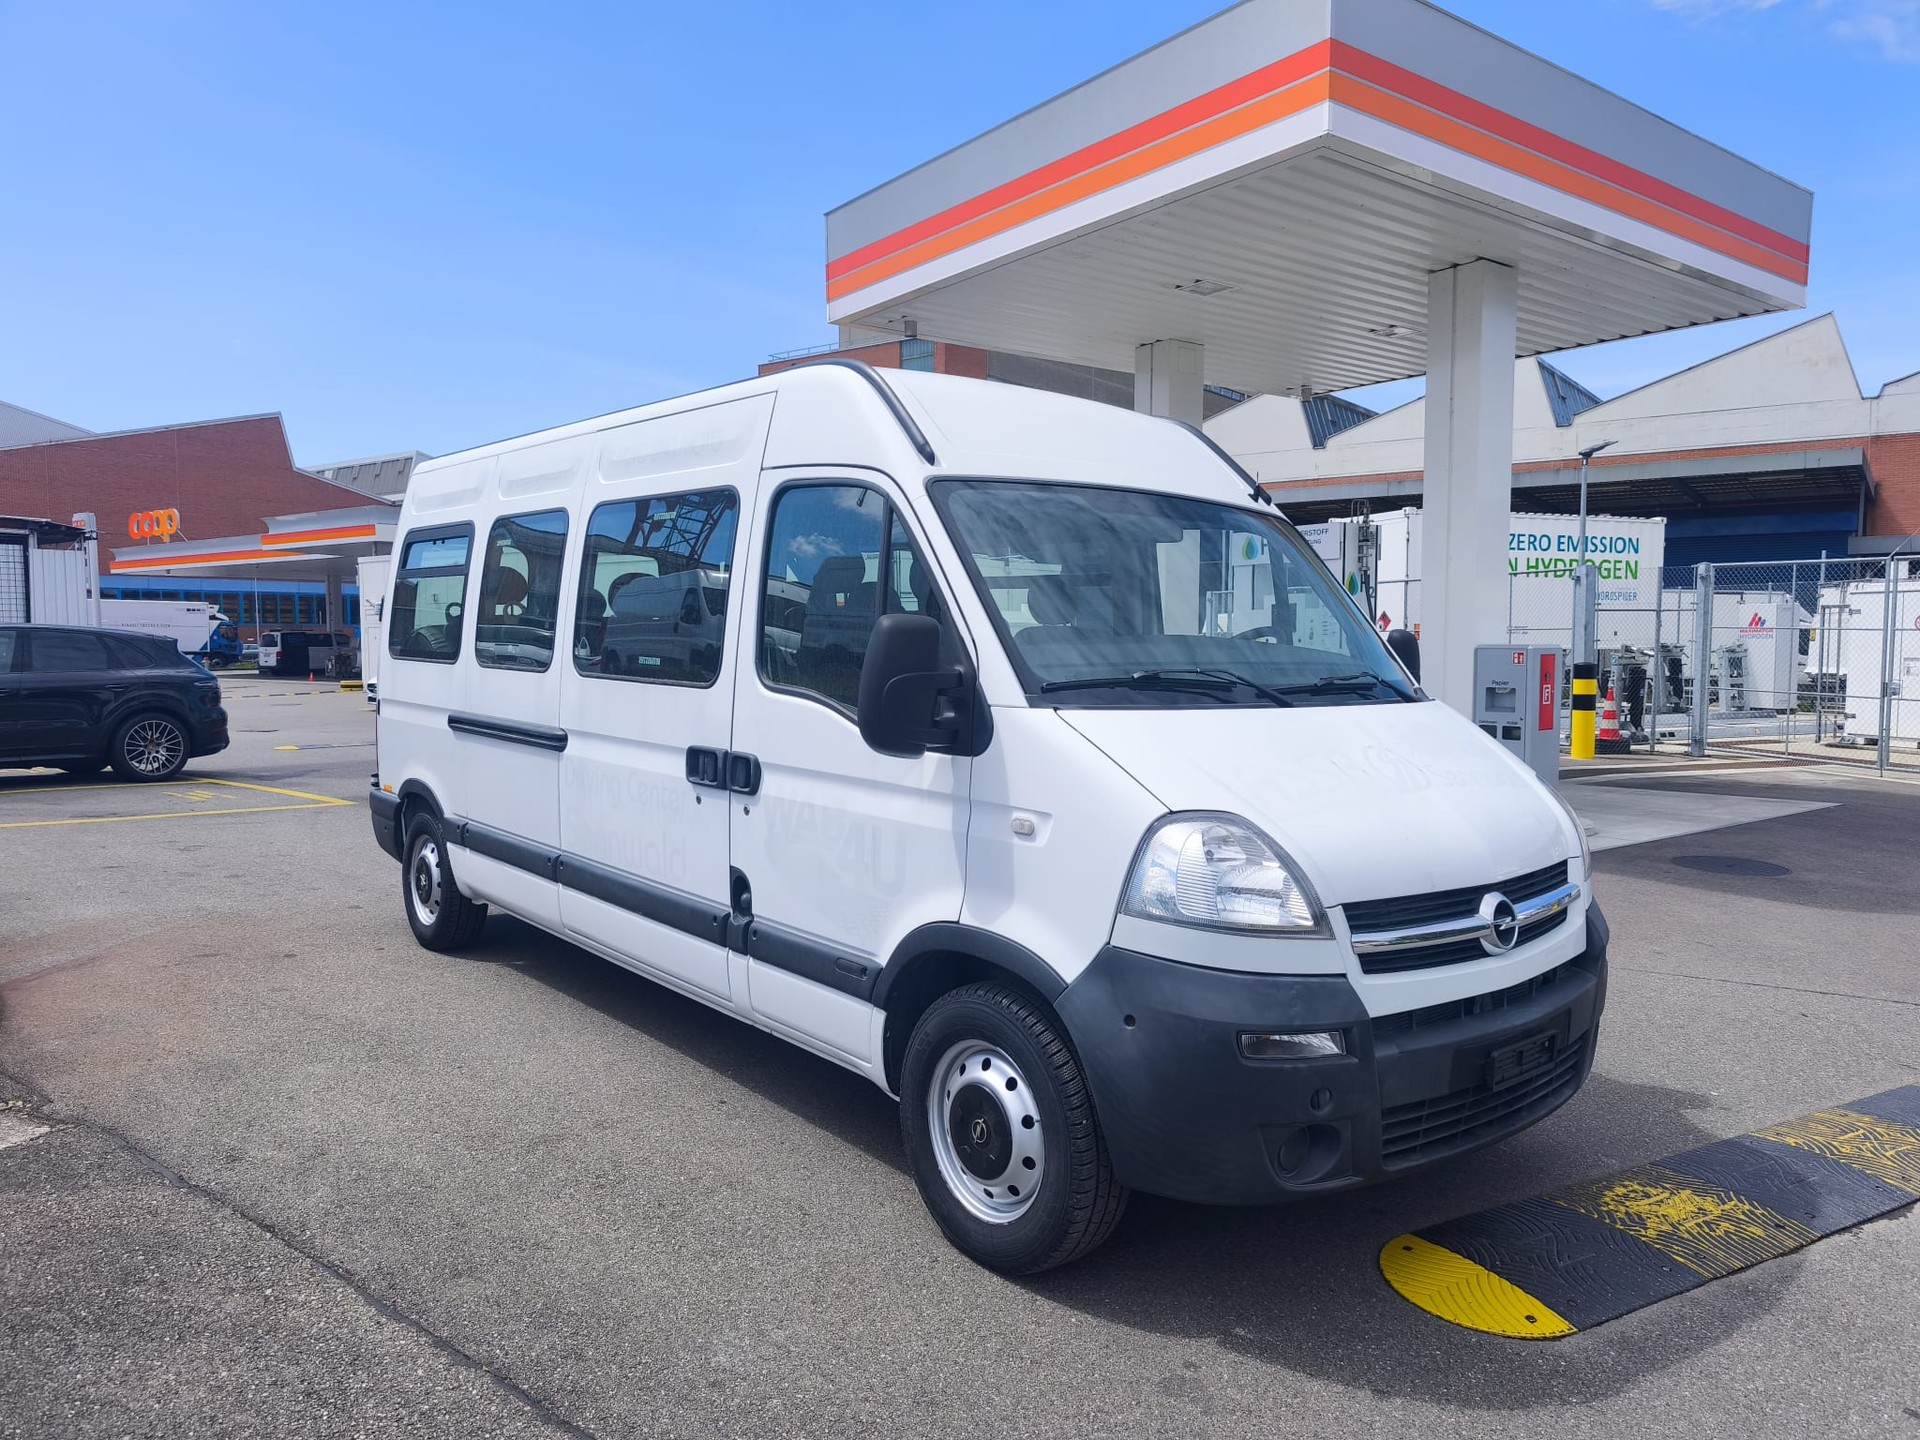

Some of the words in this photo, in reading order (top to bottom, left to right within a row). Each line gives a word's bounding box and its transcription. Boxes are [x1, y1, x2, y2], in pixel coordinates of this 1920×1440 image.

[129, 507, 178, 543] coop
[1300, 528, 1329, 537] ERSTOFF
[1509, 533, 1552, 552] ZERO
[1557, 534, 1640, 555] EMISSION
[1508, 557, 1518, 577] N
[1491, 679, 1510, 687] Papier
